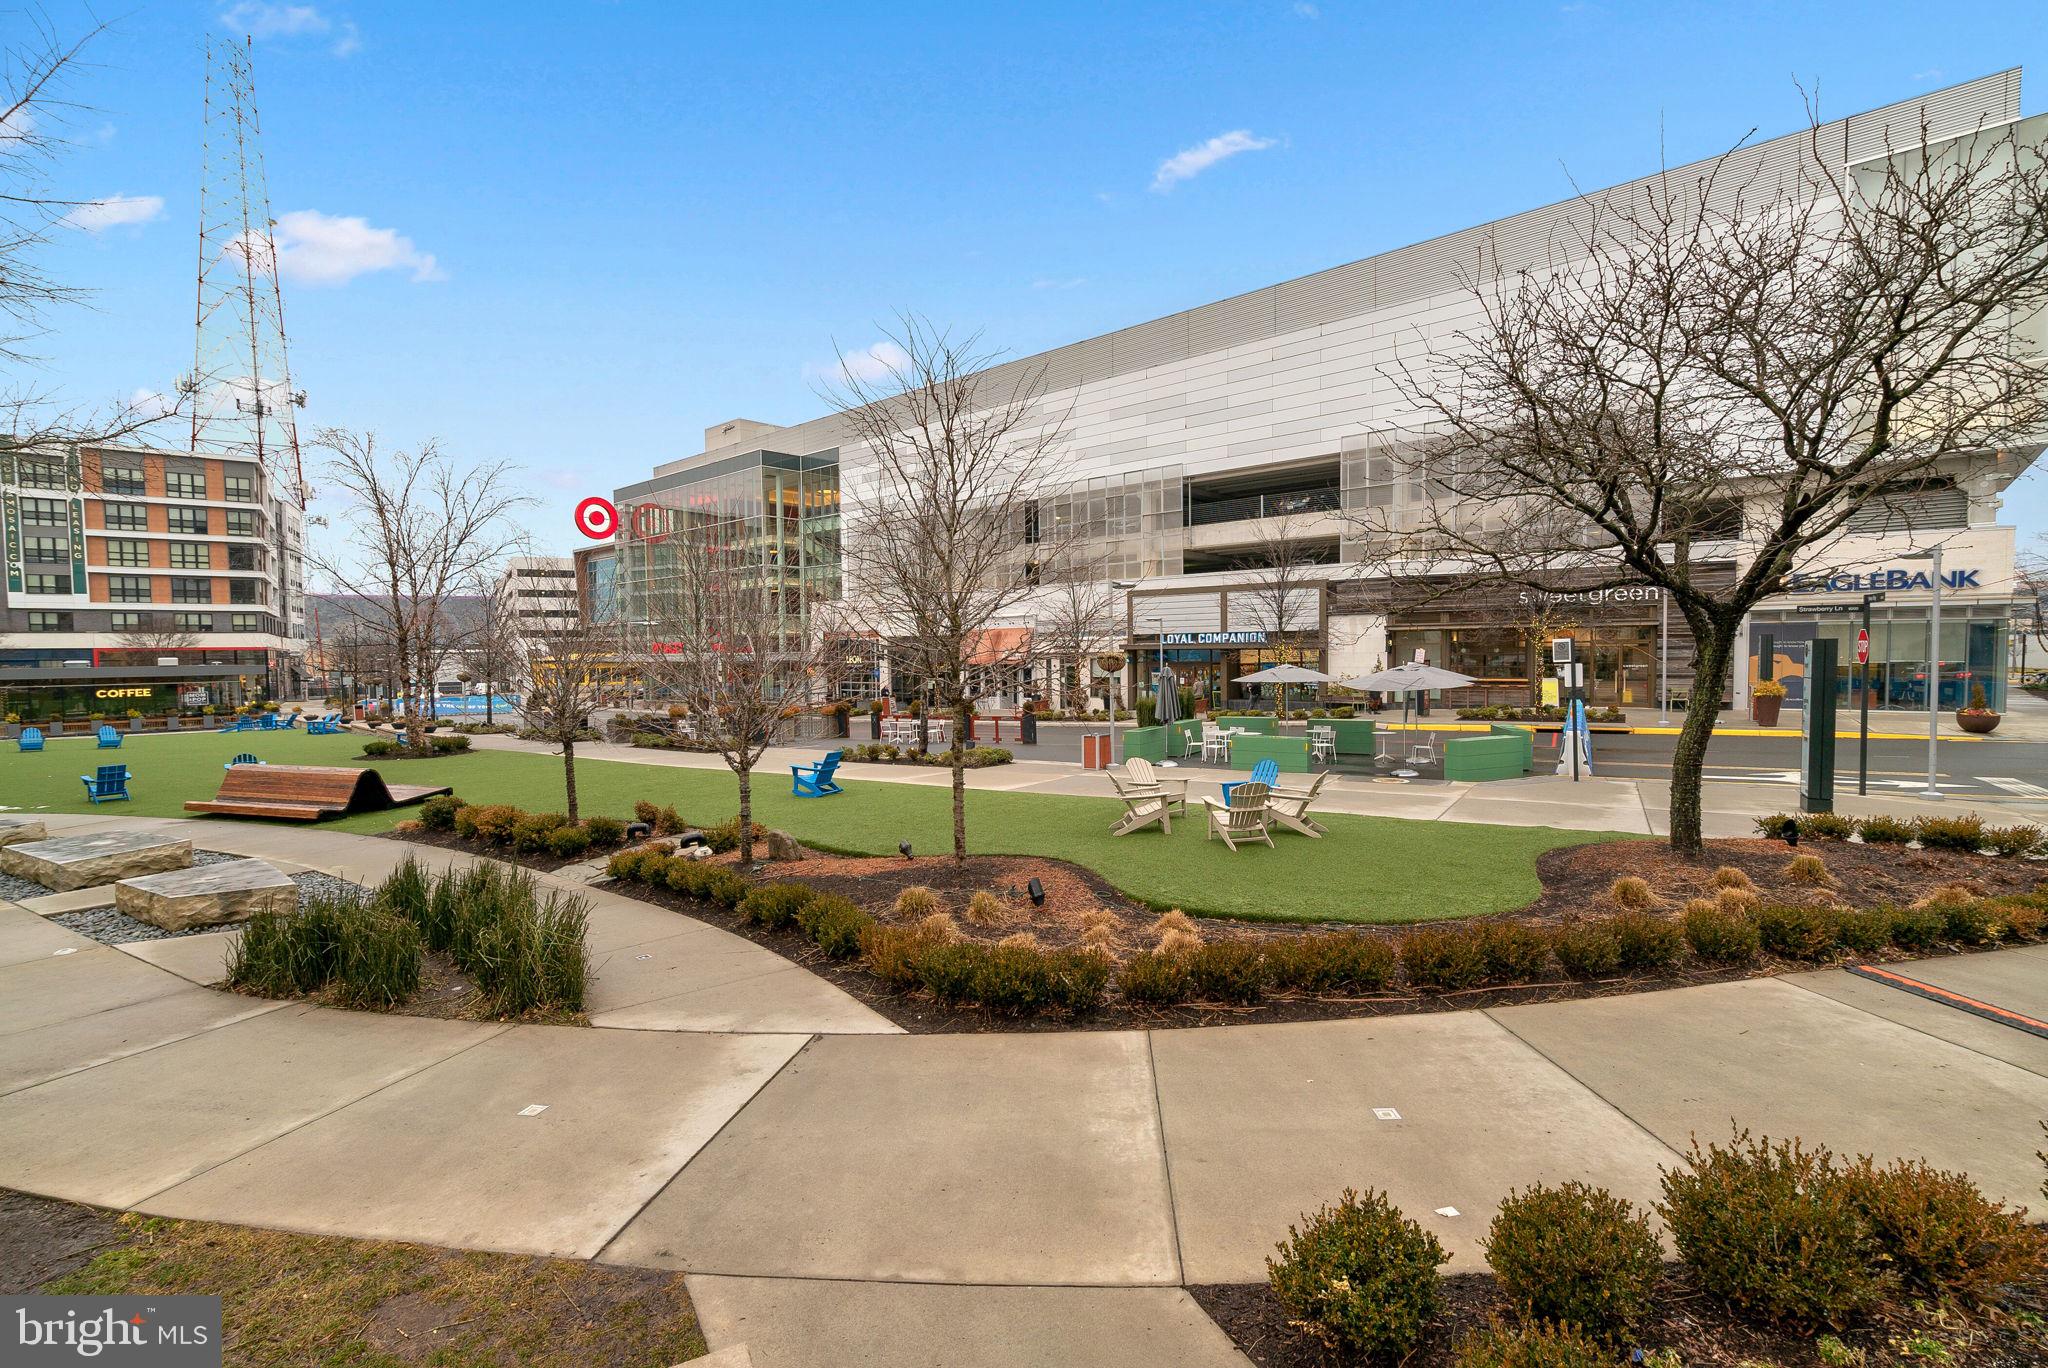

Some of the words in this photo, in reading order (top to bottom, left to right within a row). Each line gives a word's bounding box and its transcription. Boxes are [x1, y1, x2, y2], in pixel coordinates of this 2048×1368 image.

[72, 503, 82, 559] LEASING
[1161, 634, 1196, 644] LOYAL
[1198, 633, 1266, 643] COMPANION
[1858, 640, 1868, 653] STOP
[96, 688, 152, 698] COFFEE
